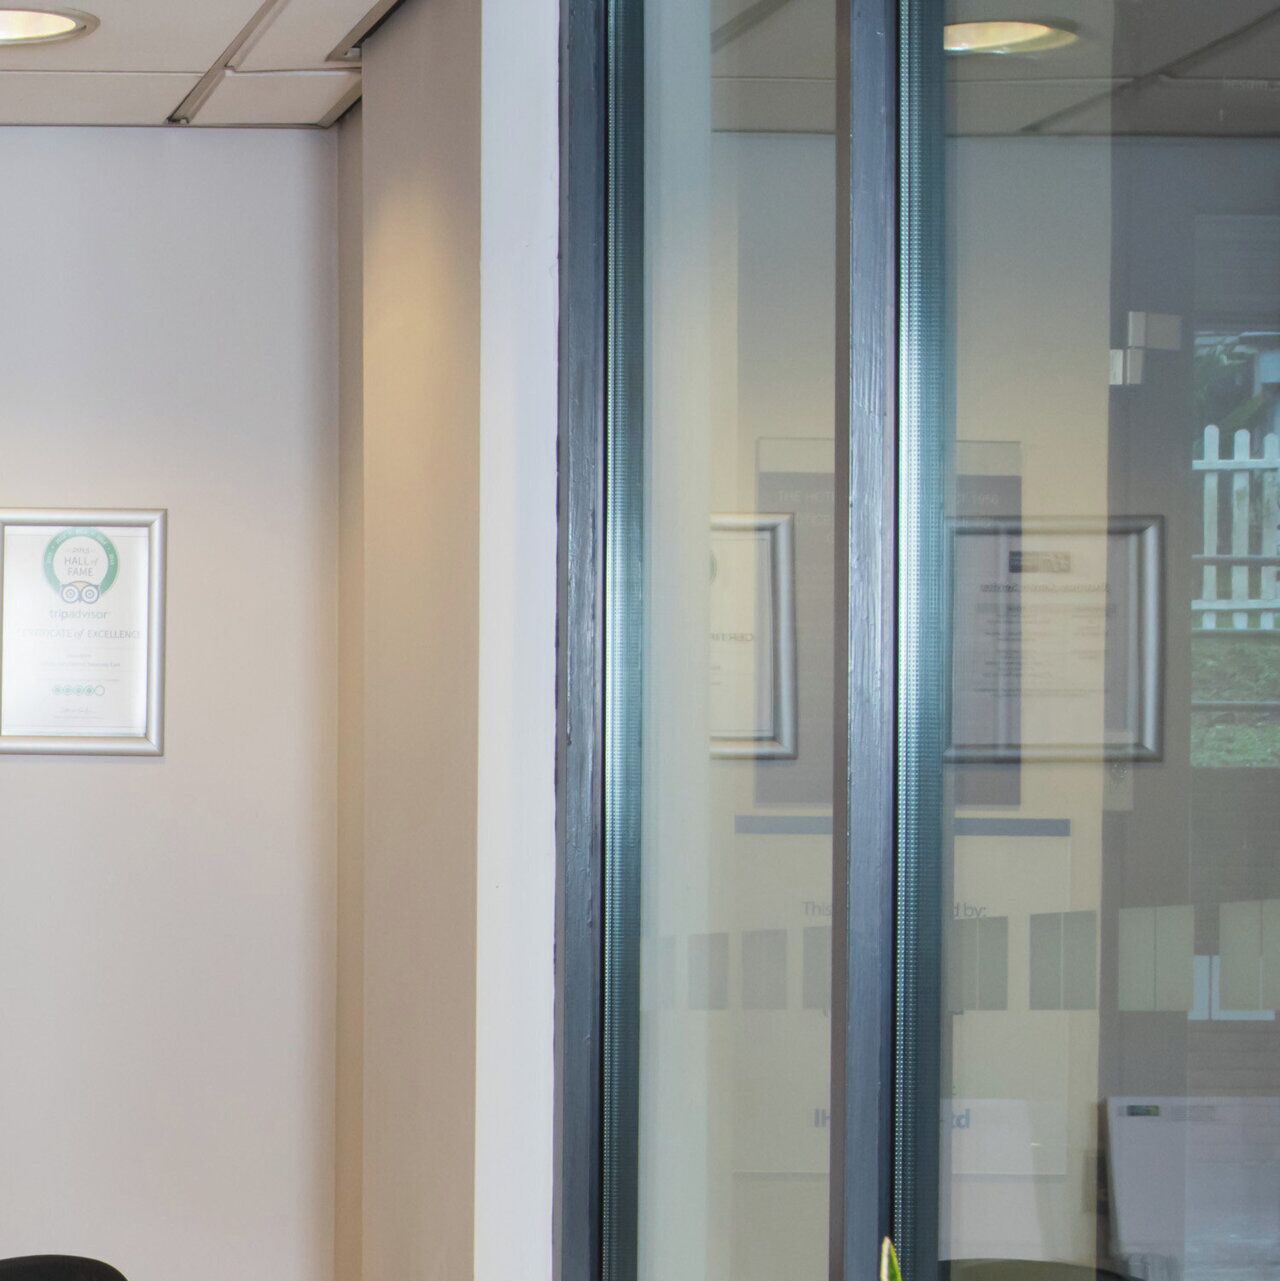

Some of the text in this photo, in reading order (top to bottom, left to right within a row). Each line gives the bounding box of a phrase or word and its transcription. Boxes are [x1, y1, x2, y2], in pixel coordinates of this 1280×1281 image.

[64, 557, 89, 566] HALL
[67, 567, 94, 577] FAME
[49, 608, 109, 621] tripadvisor
